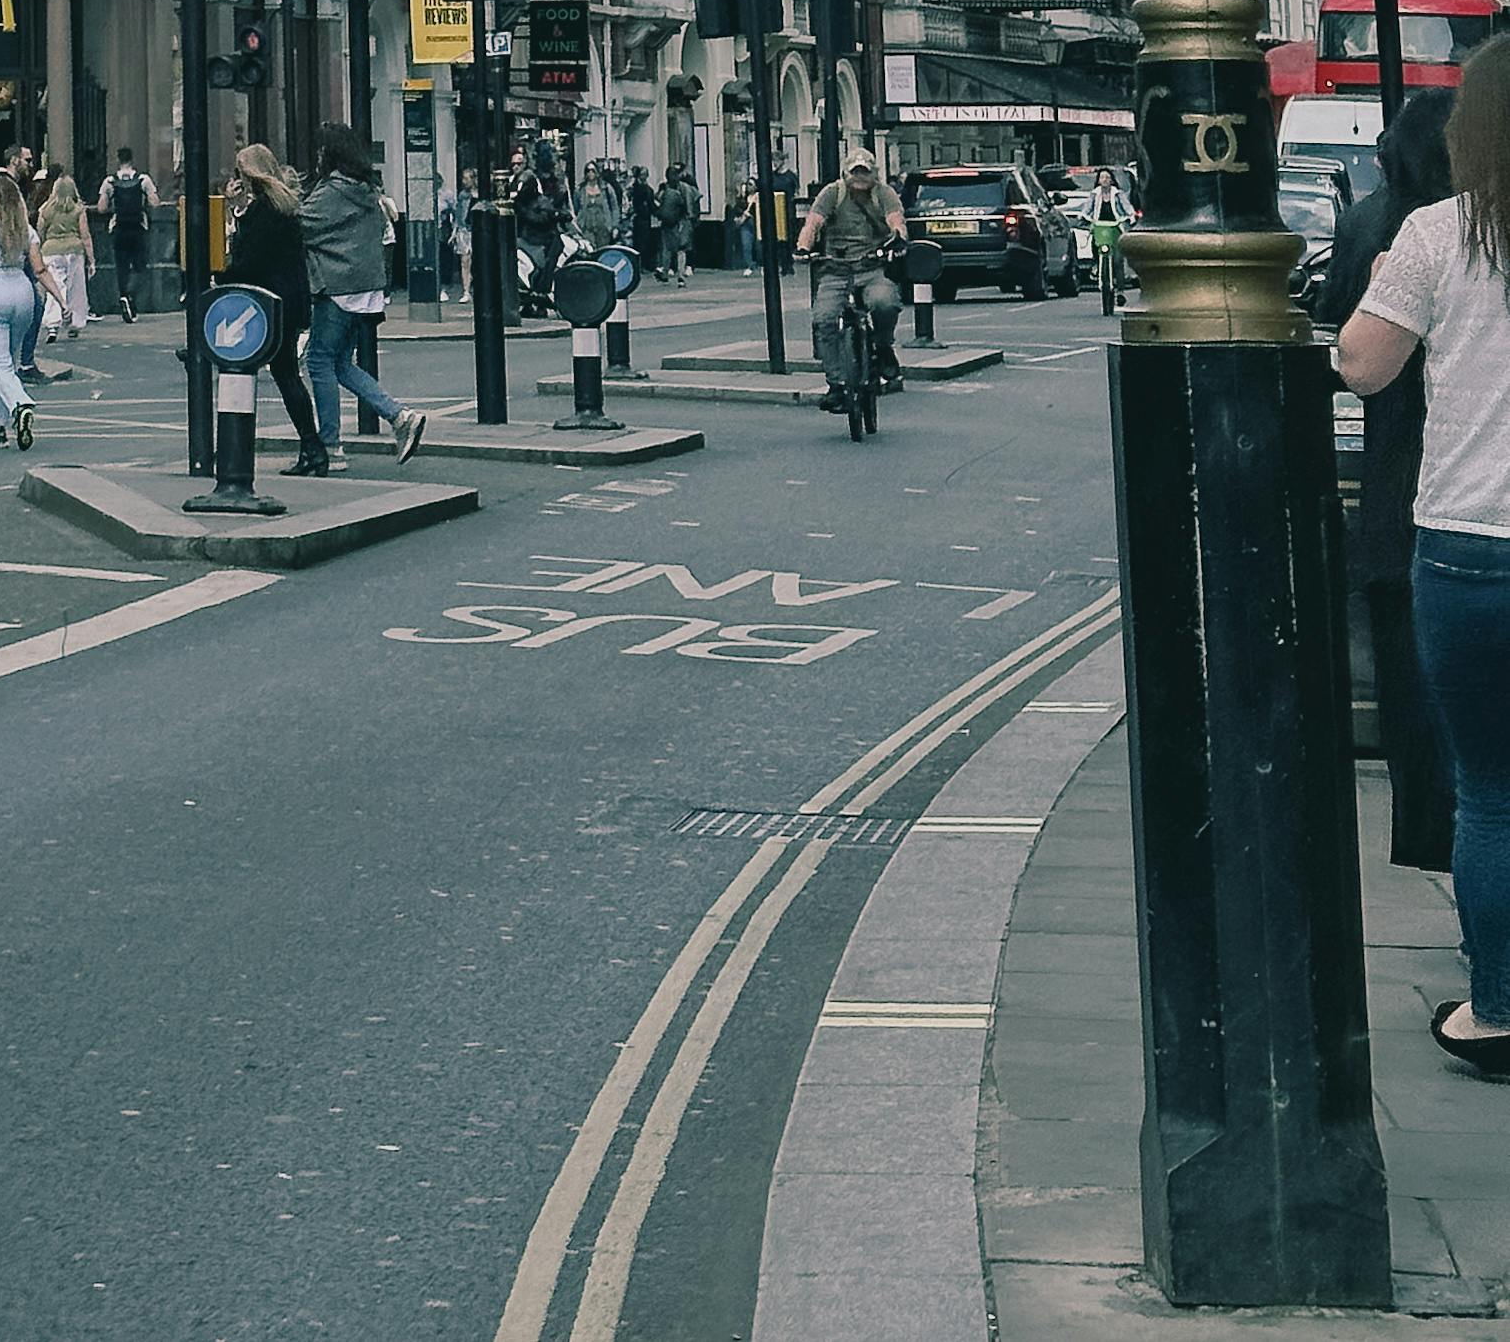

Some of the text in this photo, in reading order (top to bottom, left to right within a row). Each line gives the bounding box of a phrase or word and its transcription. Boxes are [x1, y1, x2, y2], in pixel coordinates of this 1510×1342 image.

[425, 7, 468, 26] REVIEWS
[536, 8, 581, 21] FOOD
[495, 36, 506, 48] P
[538, 40, 580, 54] WINE
[541, 71, 577, 84] ATM
[456, 555, 1037, 620] LANE
[382, 605, 880, 666] BUS
